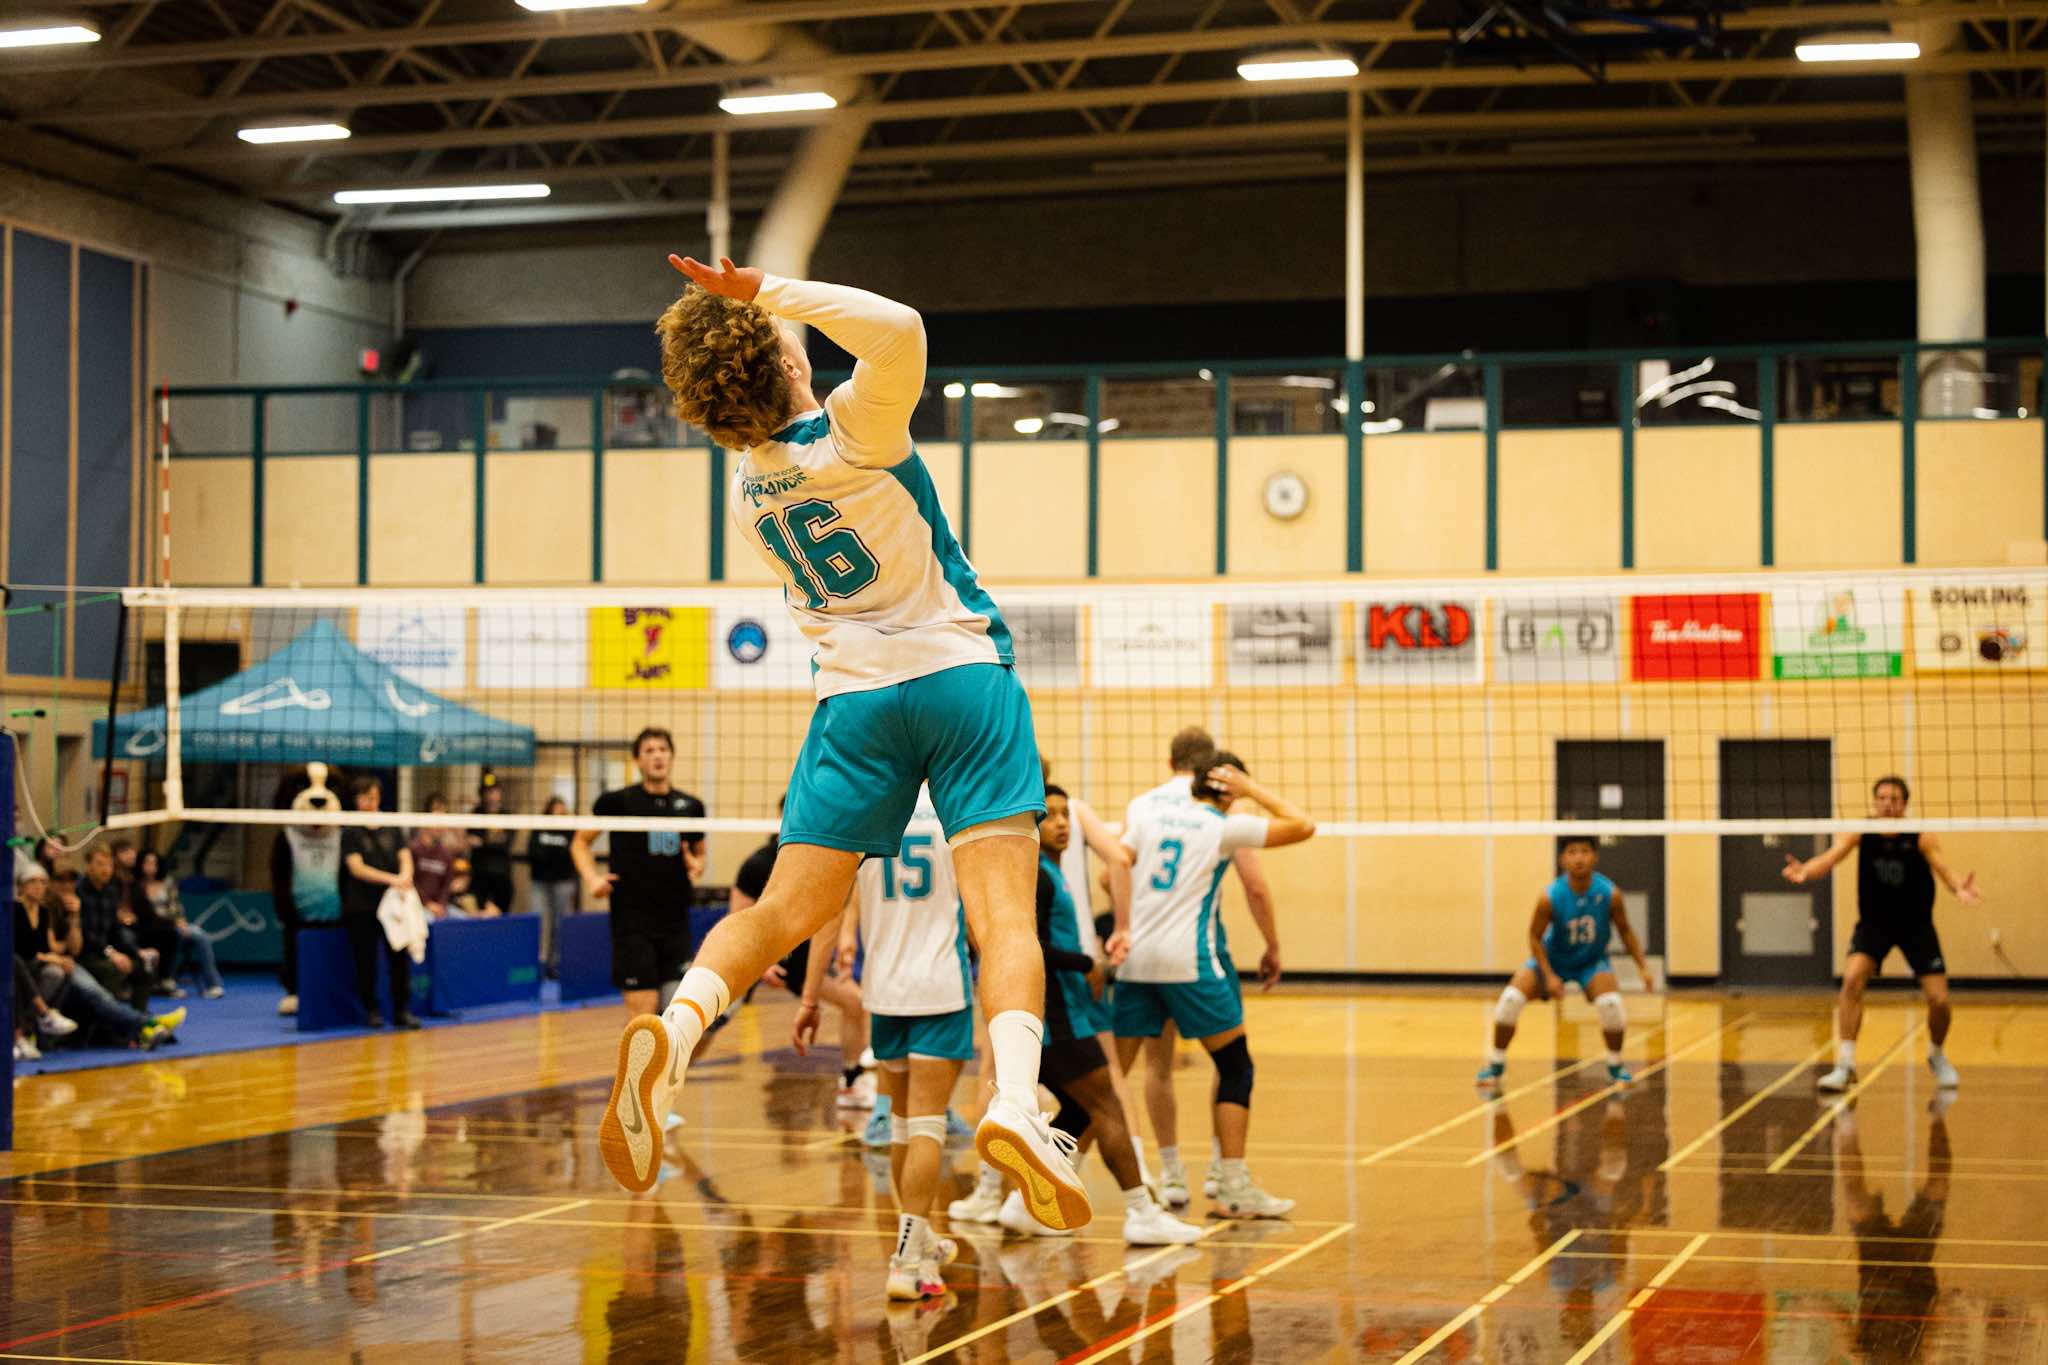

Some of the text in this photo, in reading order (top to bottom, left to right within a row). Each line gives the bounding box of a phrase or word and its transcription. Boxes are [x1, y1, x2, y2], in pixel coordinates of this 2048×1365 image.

[755, 498, 880, 609] 16
[1931, 586, 2028, 605] BOWLING
[882, 834, 935, 900] 15
[1149, 837, 1184, 893] 3
[1568, 915, 1596, 946] 13
